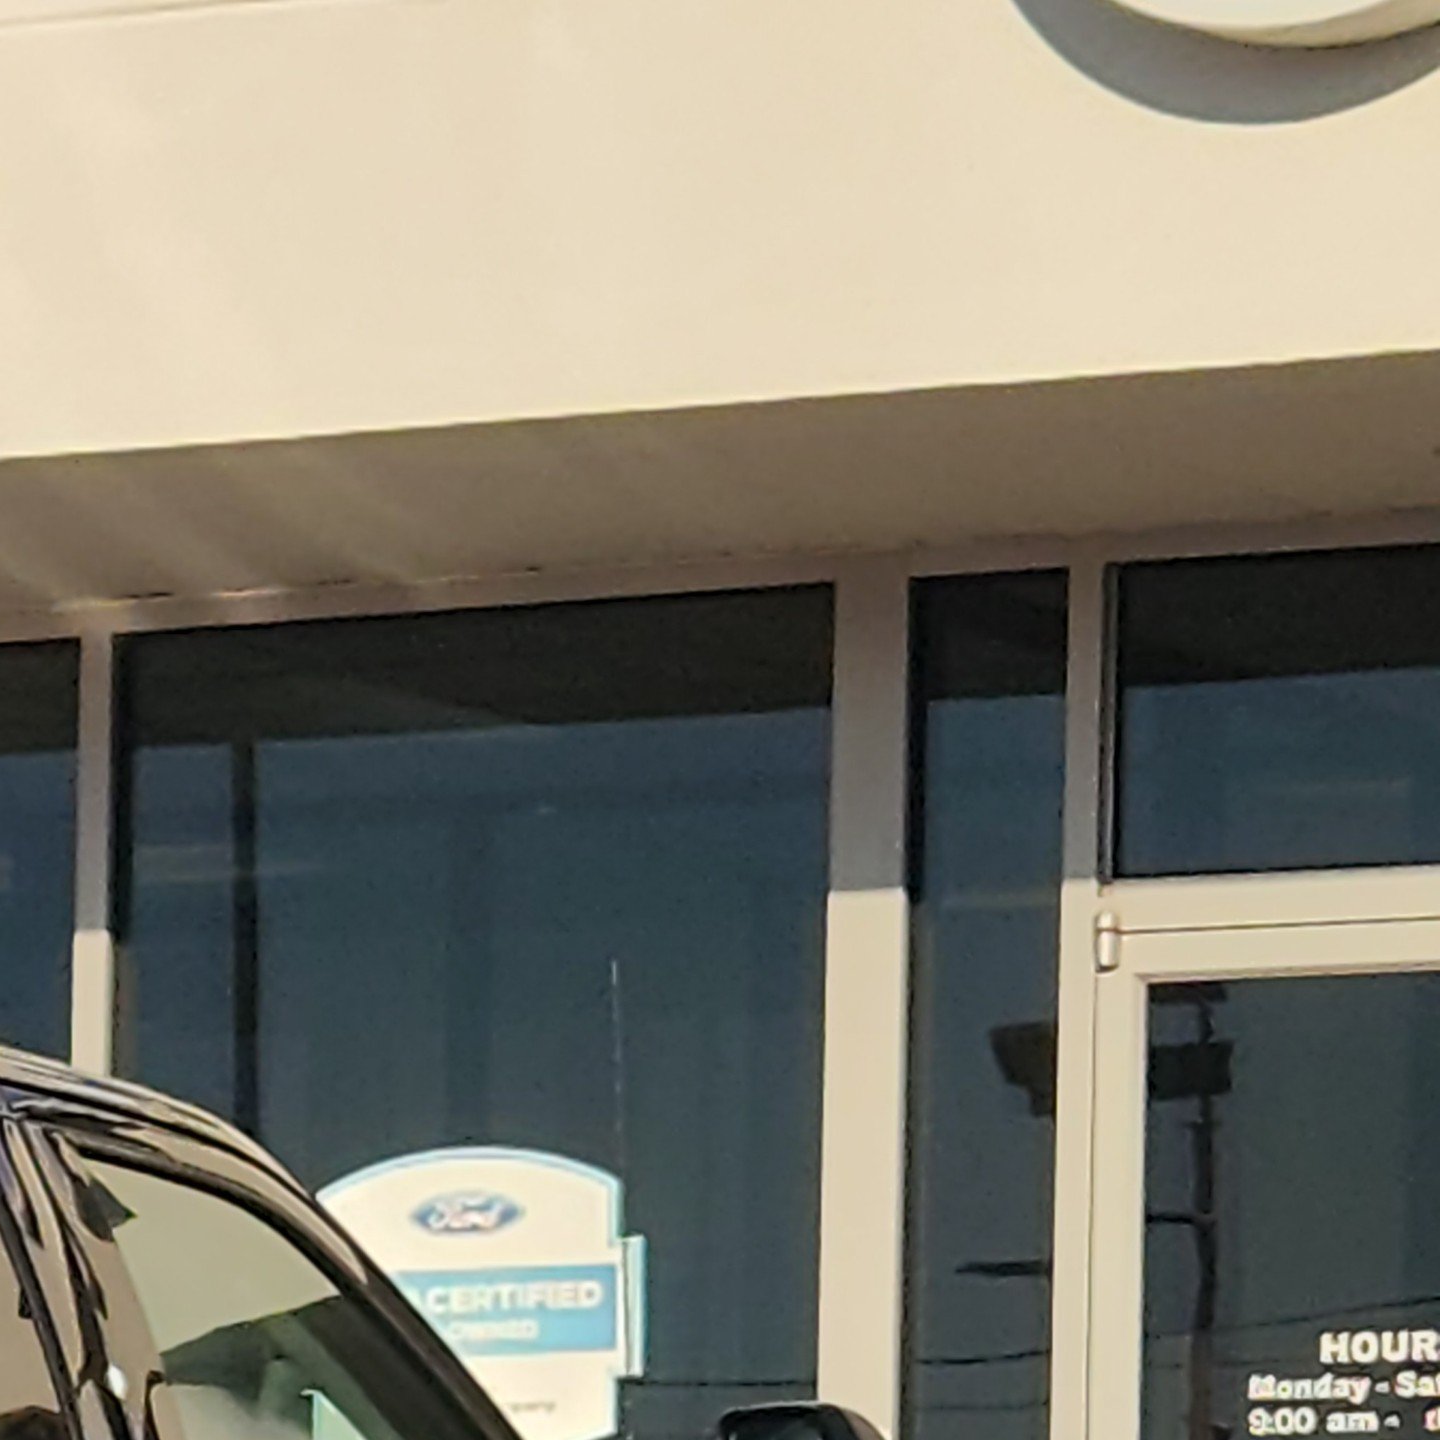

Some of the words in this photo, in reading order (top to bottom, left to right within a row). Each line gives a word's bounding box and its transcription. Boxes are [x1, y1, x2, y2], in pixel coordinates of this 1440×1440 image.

[422, 1192, 512, 1232] Ford
[427, 1280, 602, 1314] CERTIFIED
[1247, 1373, 1371, 1405] Monday
[1248, 1407, 1317, 1435] 9:00
[1326, 1411, 1379, 1433] am
